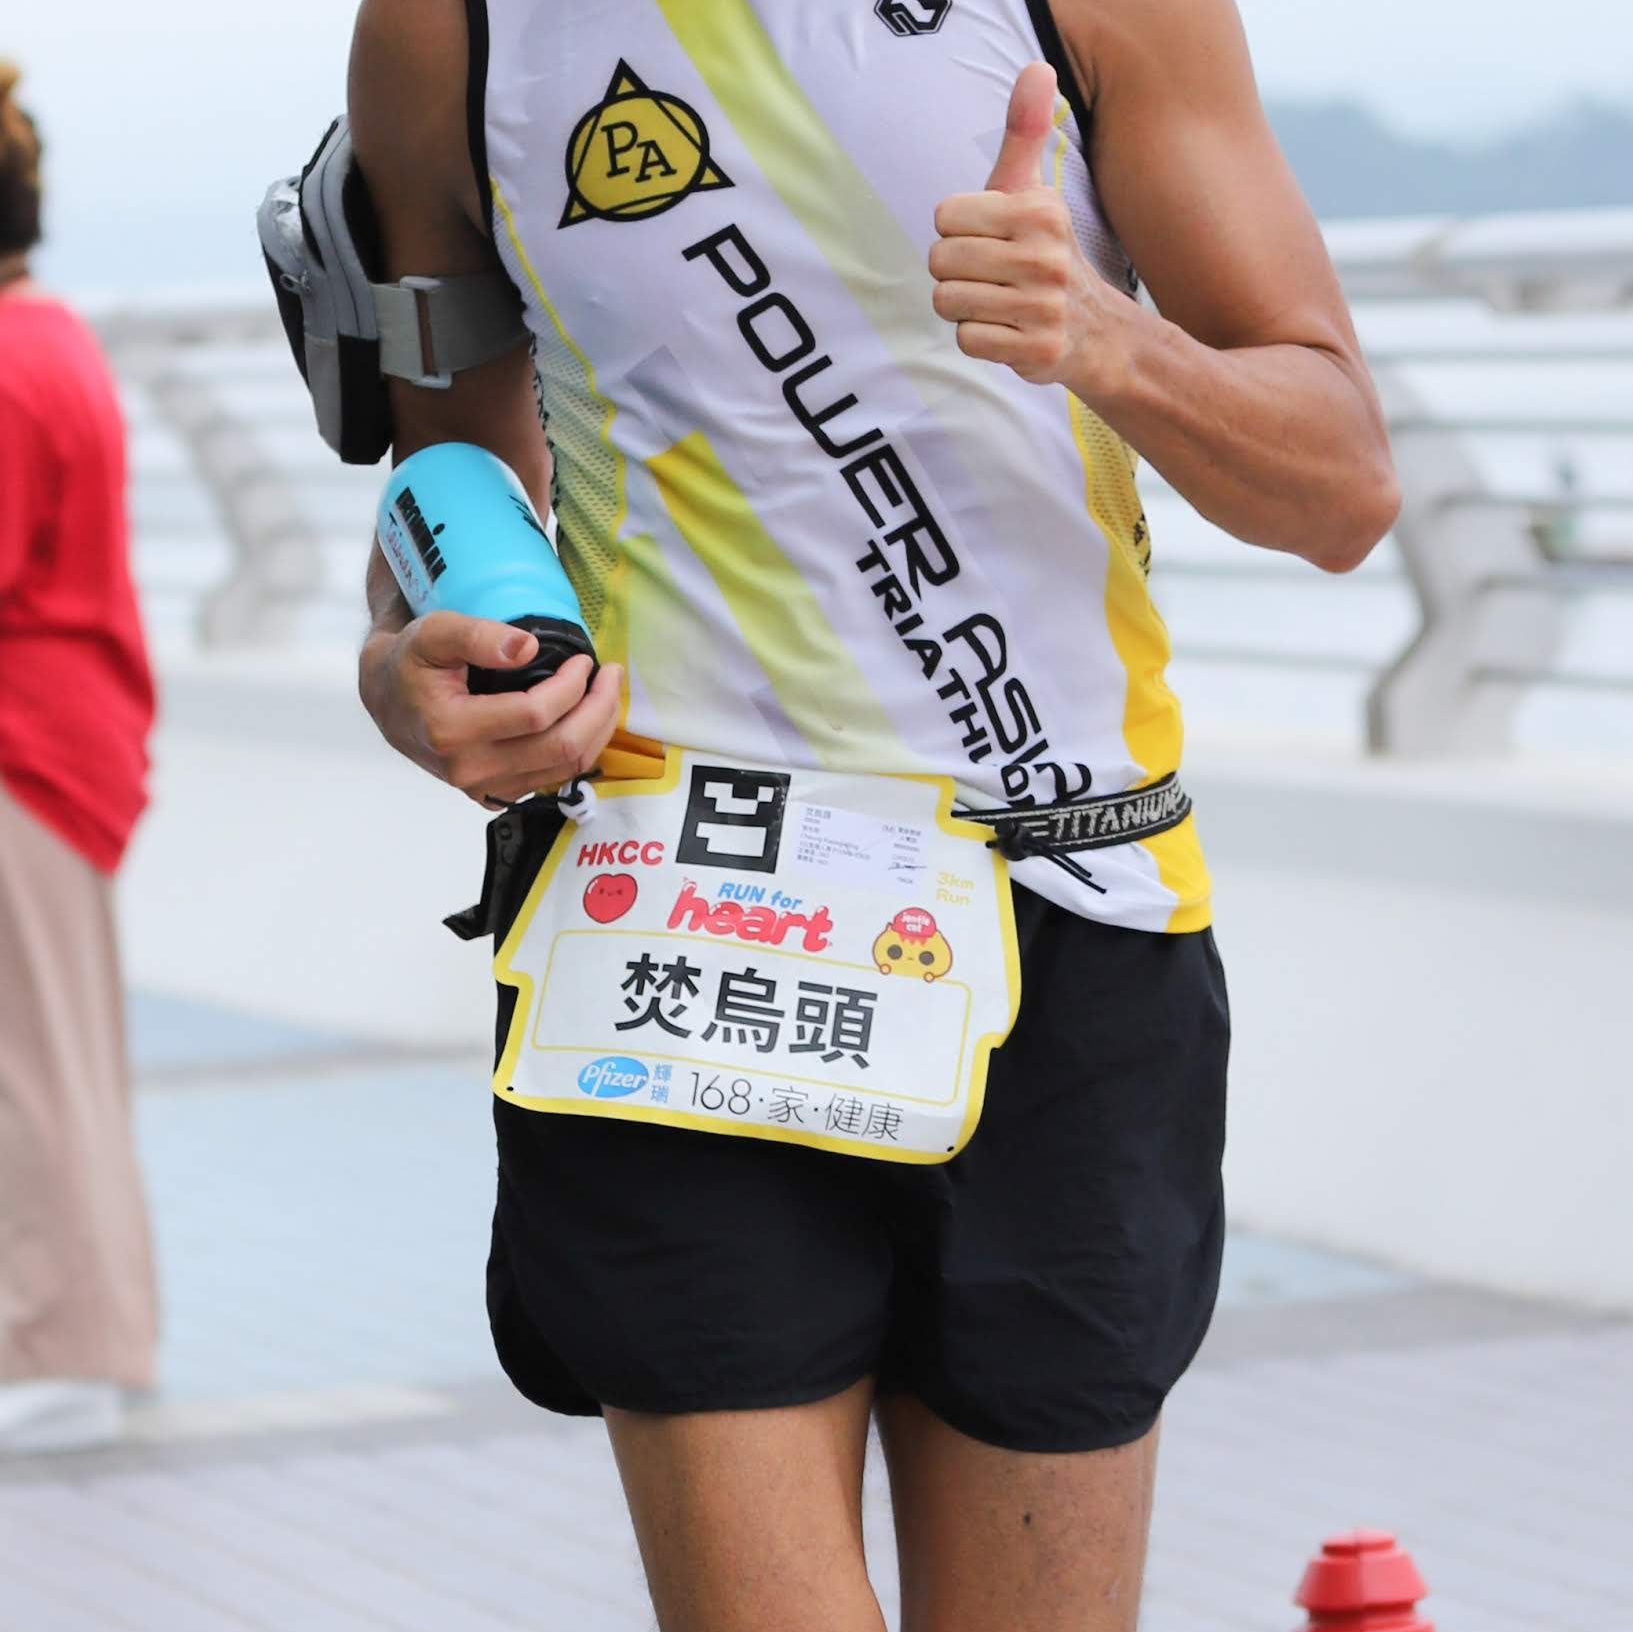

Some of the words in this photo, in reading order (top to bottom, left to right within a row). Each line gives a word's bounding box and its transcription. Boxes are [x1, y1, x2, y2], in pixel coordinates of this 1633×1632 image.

[601, 121, 677, 183] PA
[681, 223, 960, 602] POWER
[576, 840, 665, 867] HKCC
[667, 880, 834, 953] heart
[719, 881, 767, 903] RUN
[771, 890, 803, 909] for
[615, 952, 878, 1069] 焚烏頭
[582, 1060, 648, 1098] Pfizer
